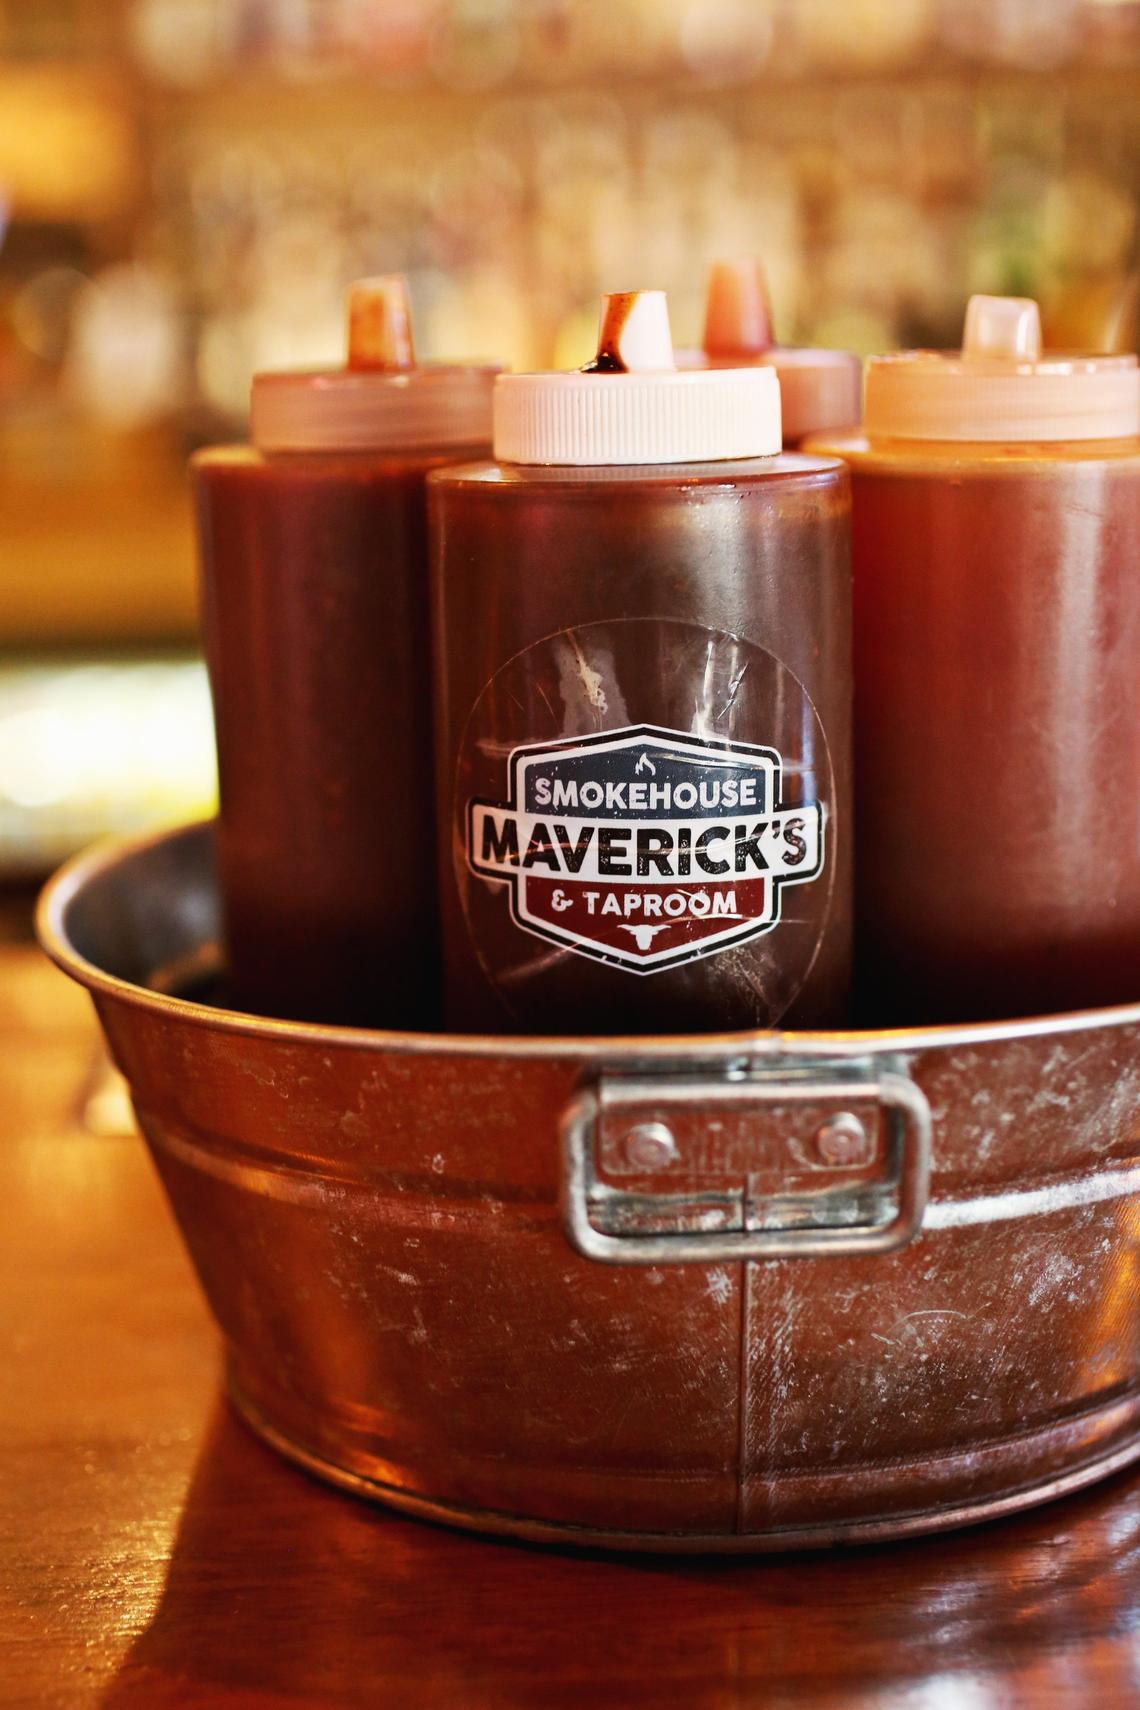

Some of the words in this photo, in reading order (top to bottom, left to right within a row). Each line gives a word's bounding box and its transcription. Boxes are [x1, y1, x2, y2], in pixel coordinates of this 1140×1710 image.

[534, 778, 757, 810] SMOKEHOUSE
[481, 814, 807, 877] MAVERICK'S
[551, 889, 573, 912] &
[582, 890, 738, 918] TAPROOM
